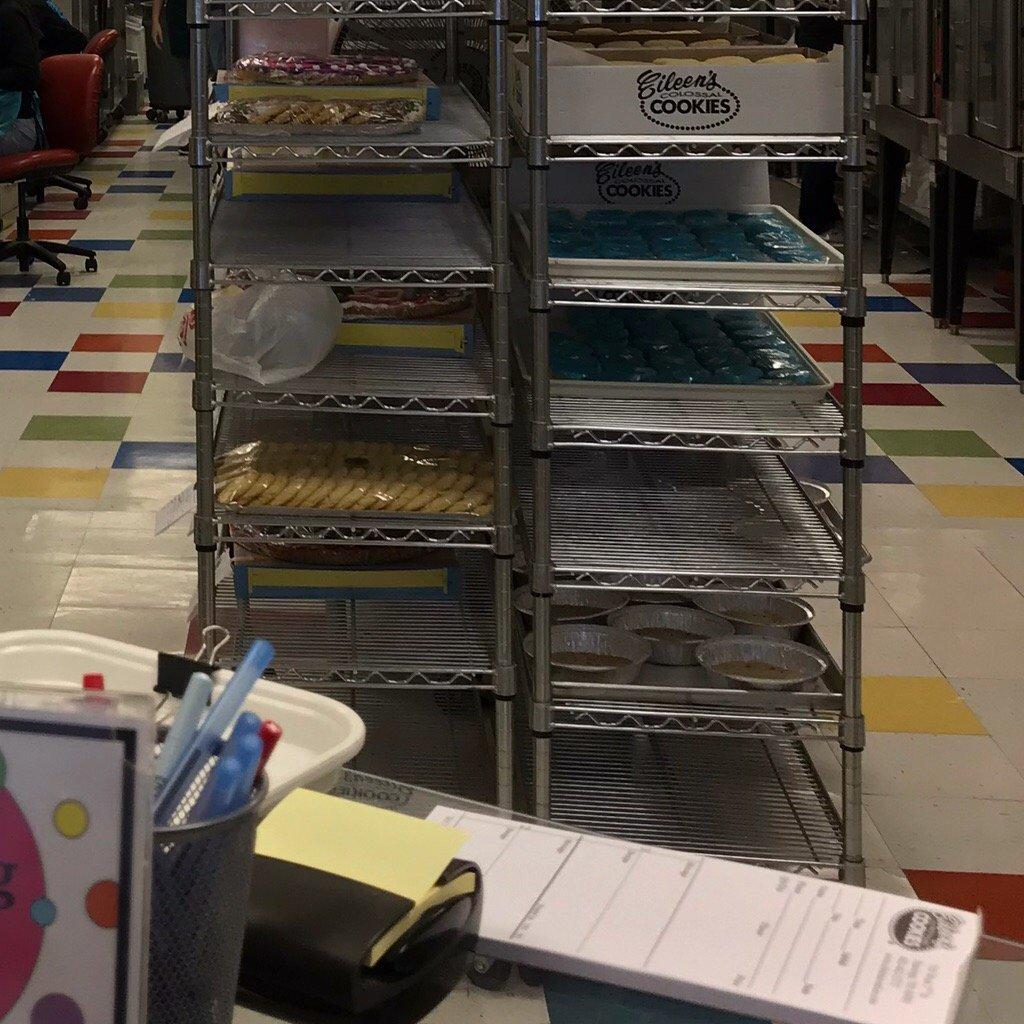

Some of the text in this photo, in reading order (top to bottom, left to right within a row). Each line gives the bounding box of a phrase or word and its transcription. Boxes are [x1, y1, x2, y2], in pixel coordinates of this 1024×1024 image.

[637, 70, 721, 99] Eileen's
[660, 91, 722, 99] COLOSSAL
[650, 99, 731, 114] COOKIES
[606, 184, 673, 197] COOKIES
